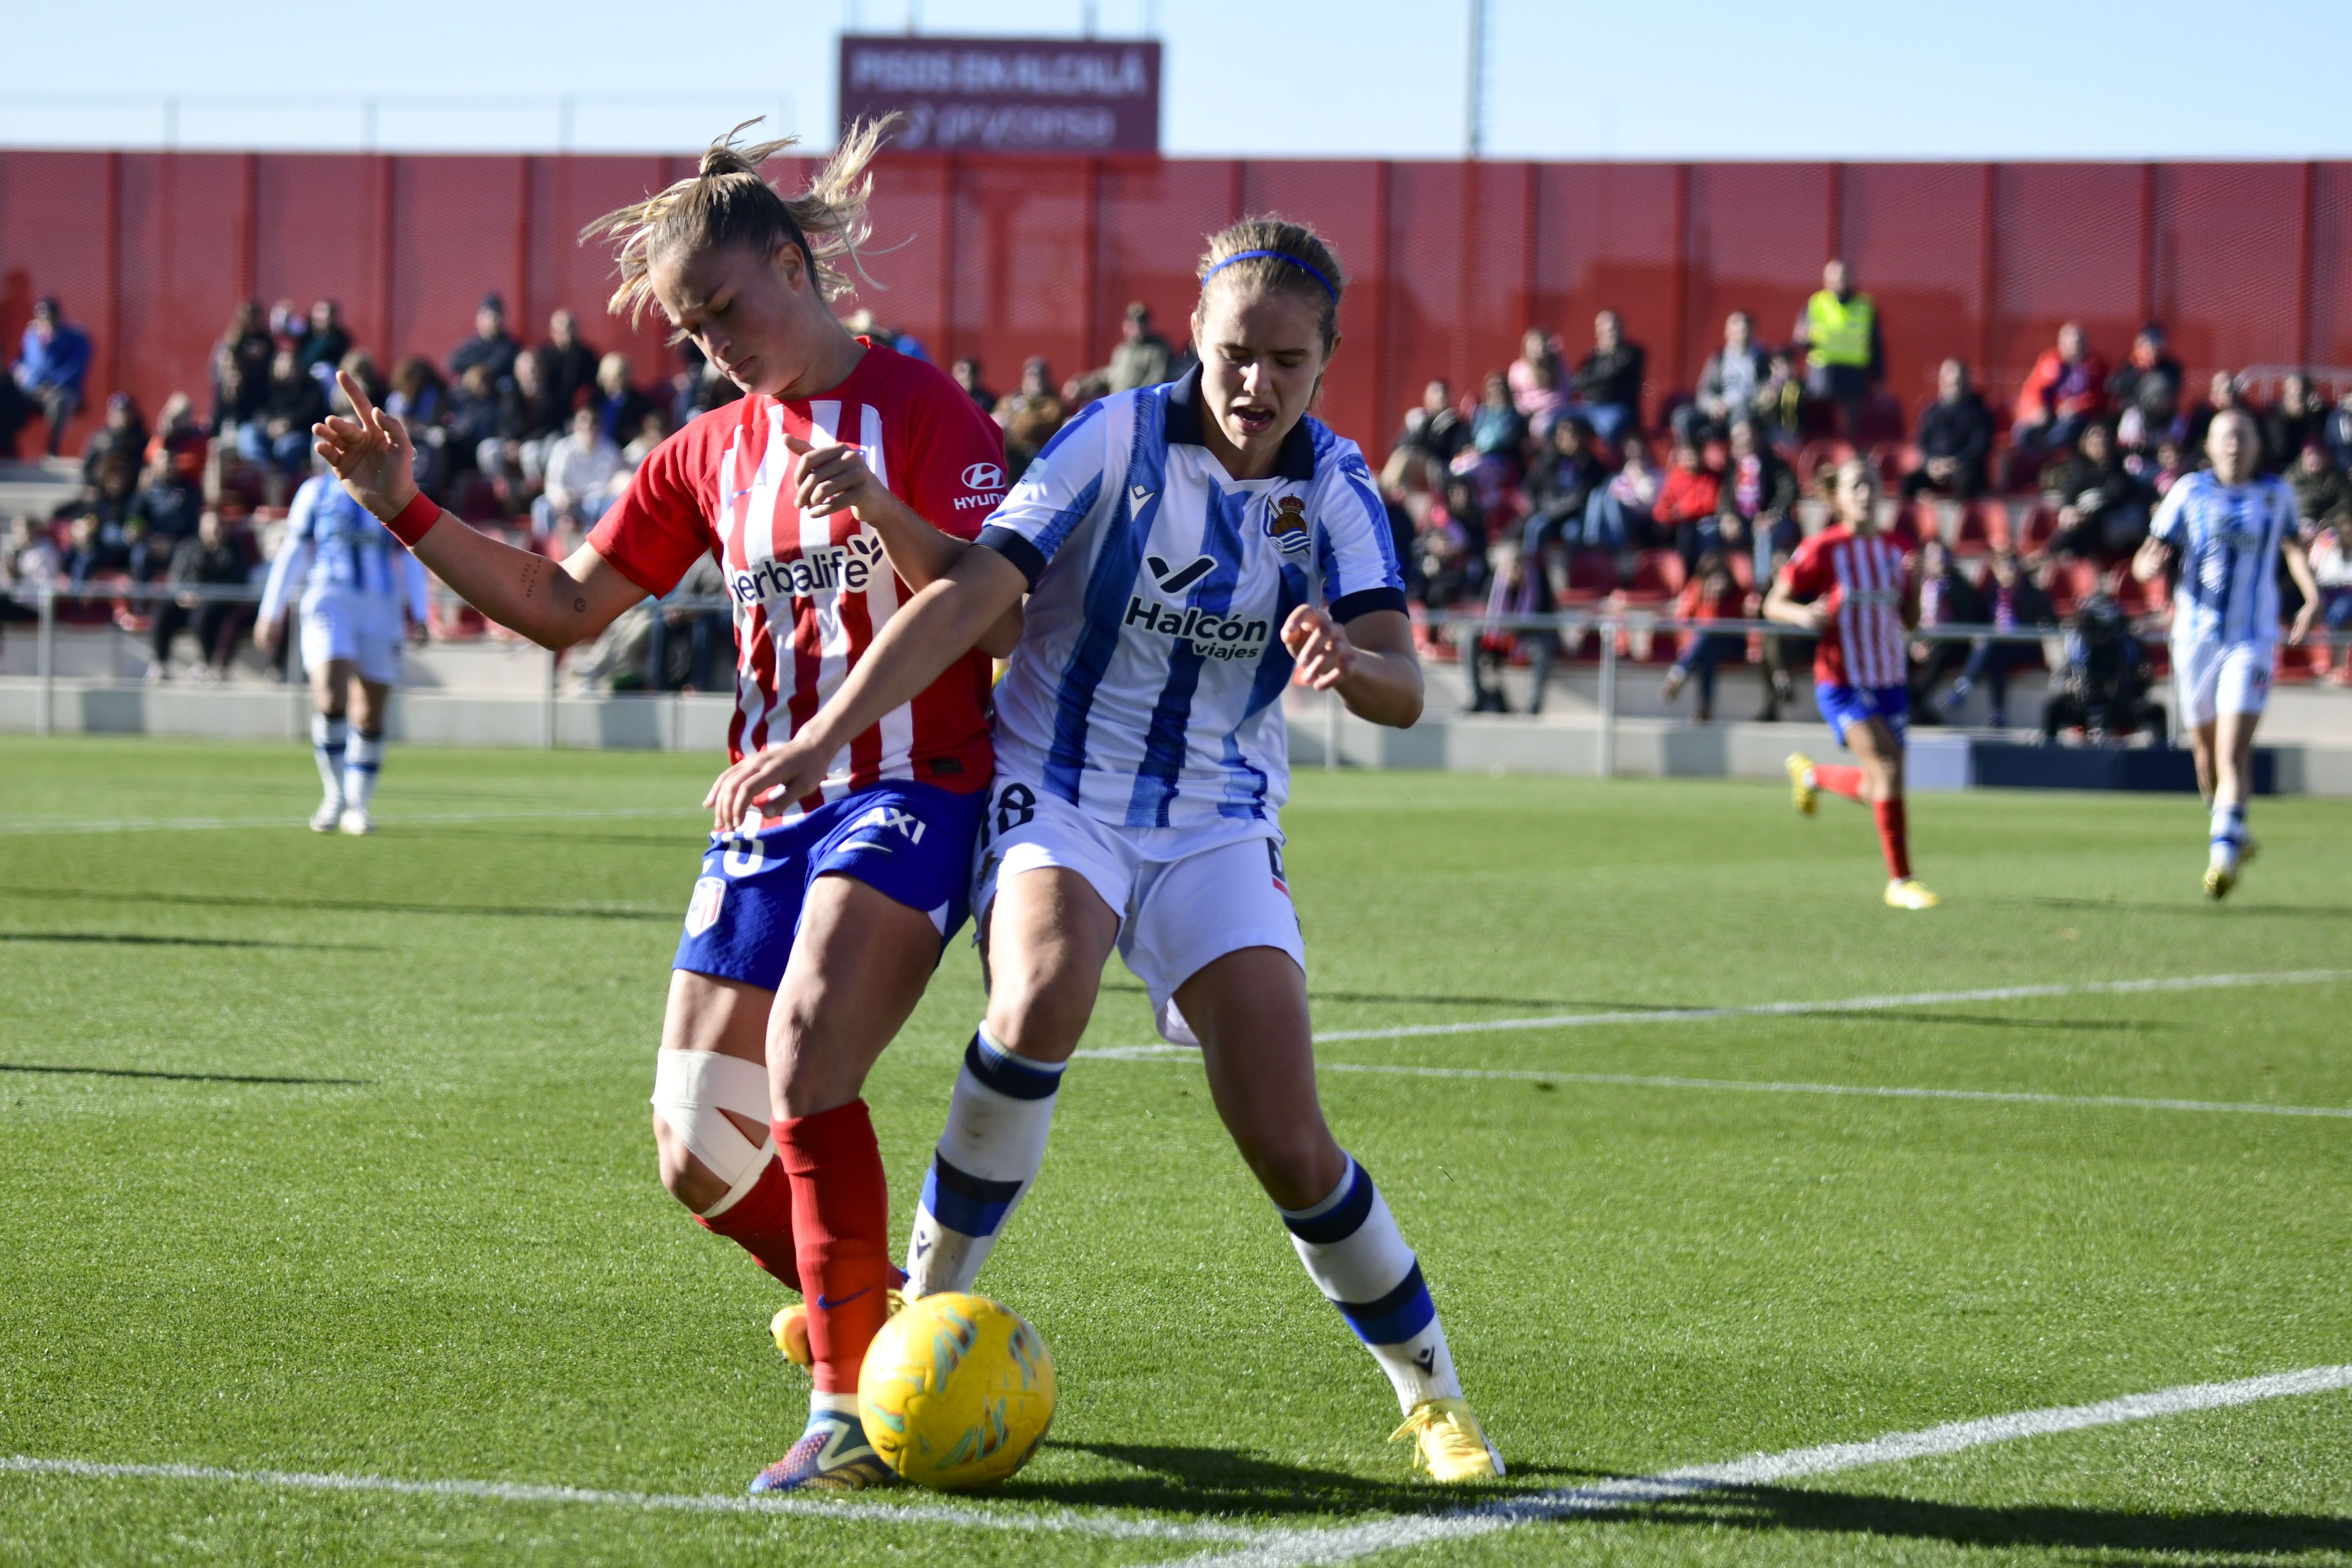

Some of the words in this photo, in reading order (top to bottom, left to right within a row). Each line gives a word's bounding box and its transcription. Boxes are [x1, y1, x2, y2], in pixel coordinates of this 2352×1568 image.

[1125, 596, 1267, 642] Halcón
[1195, 642, 1258, 662] viajes
[848, 806, 926, 845] AXI
